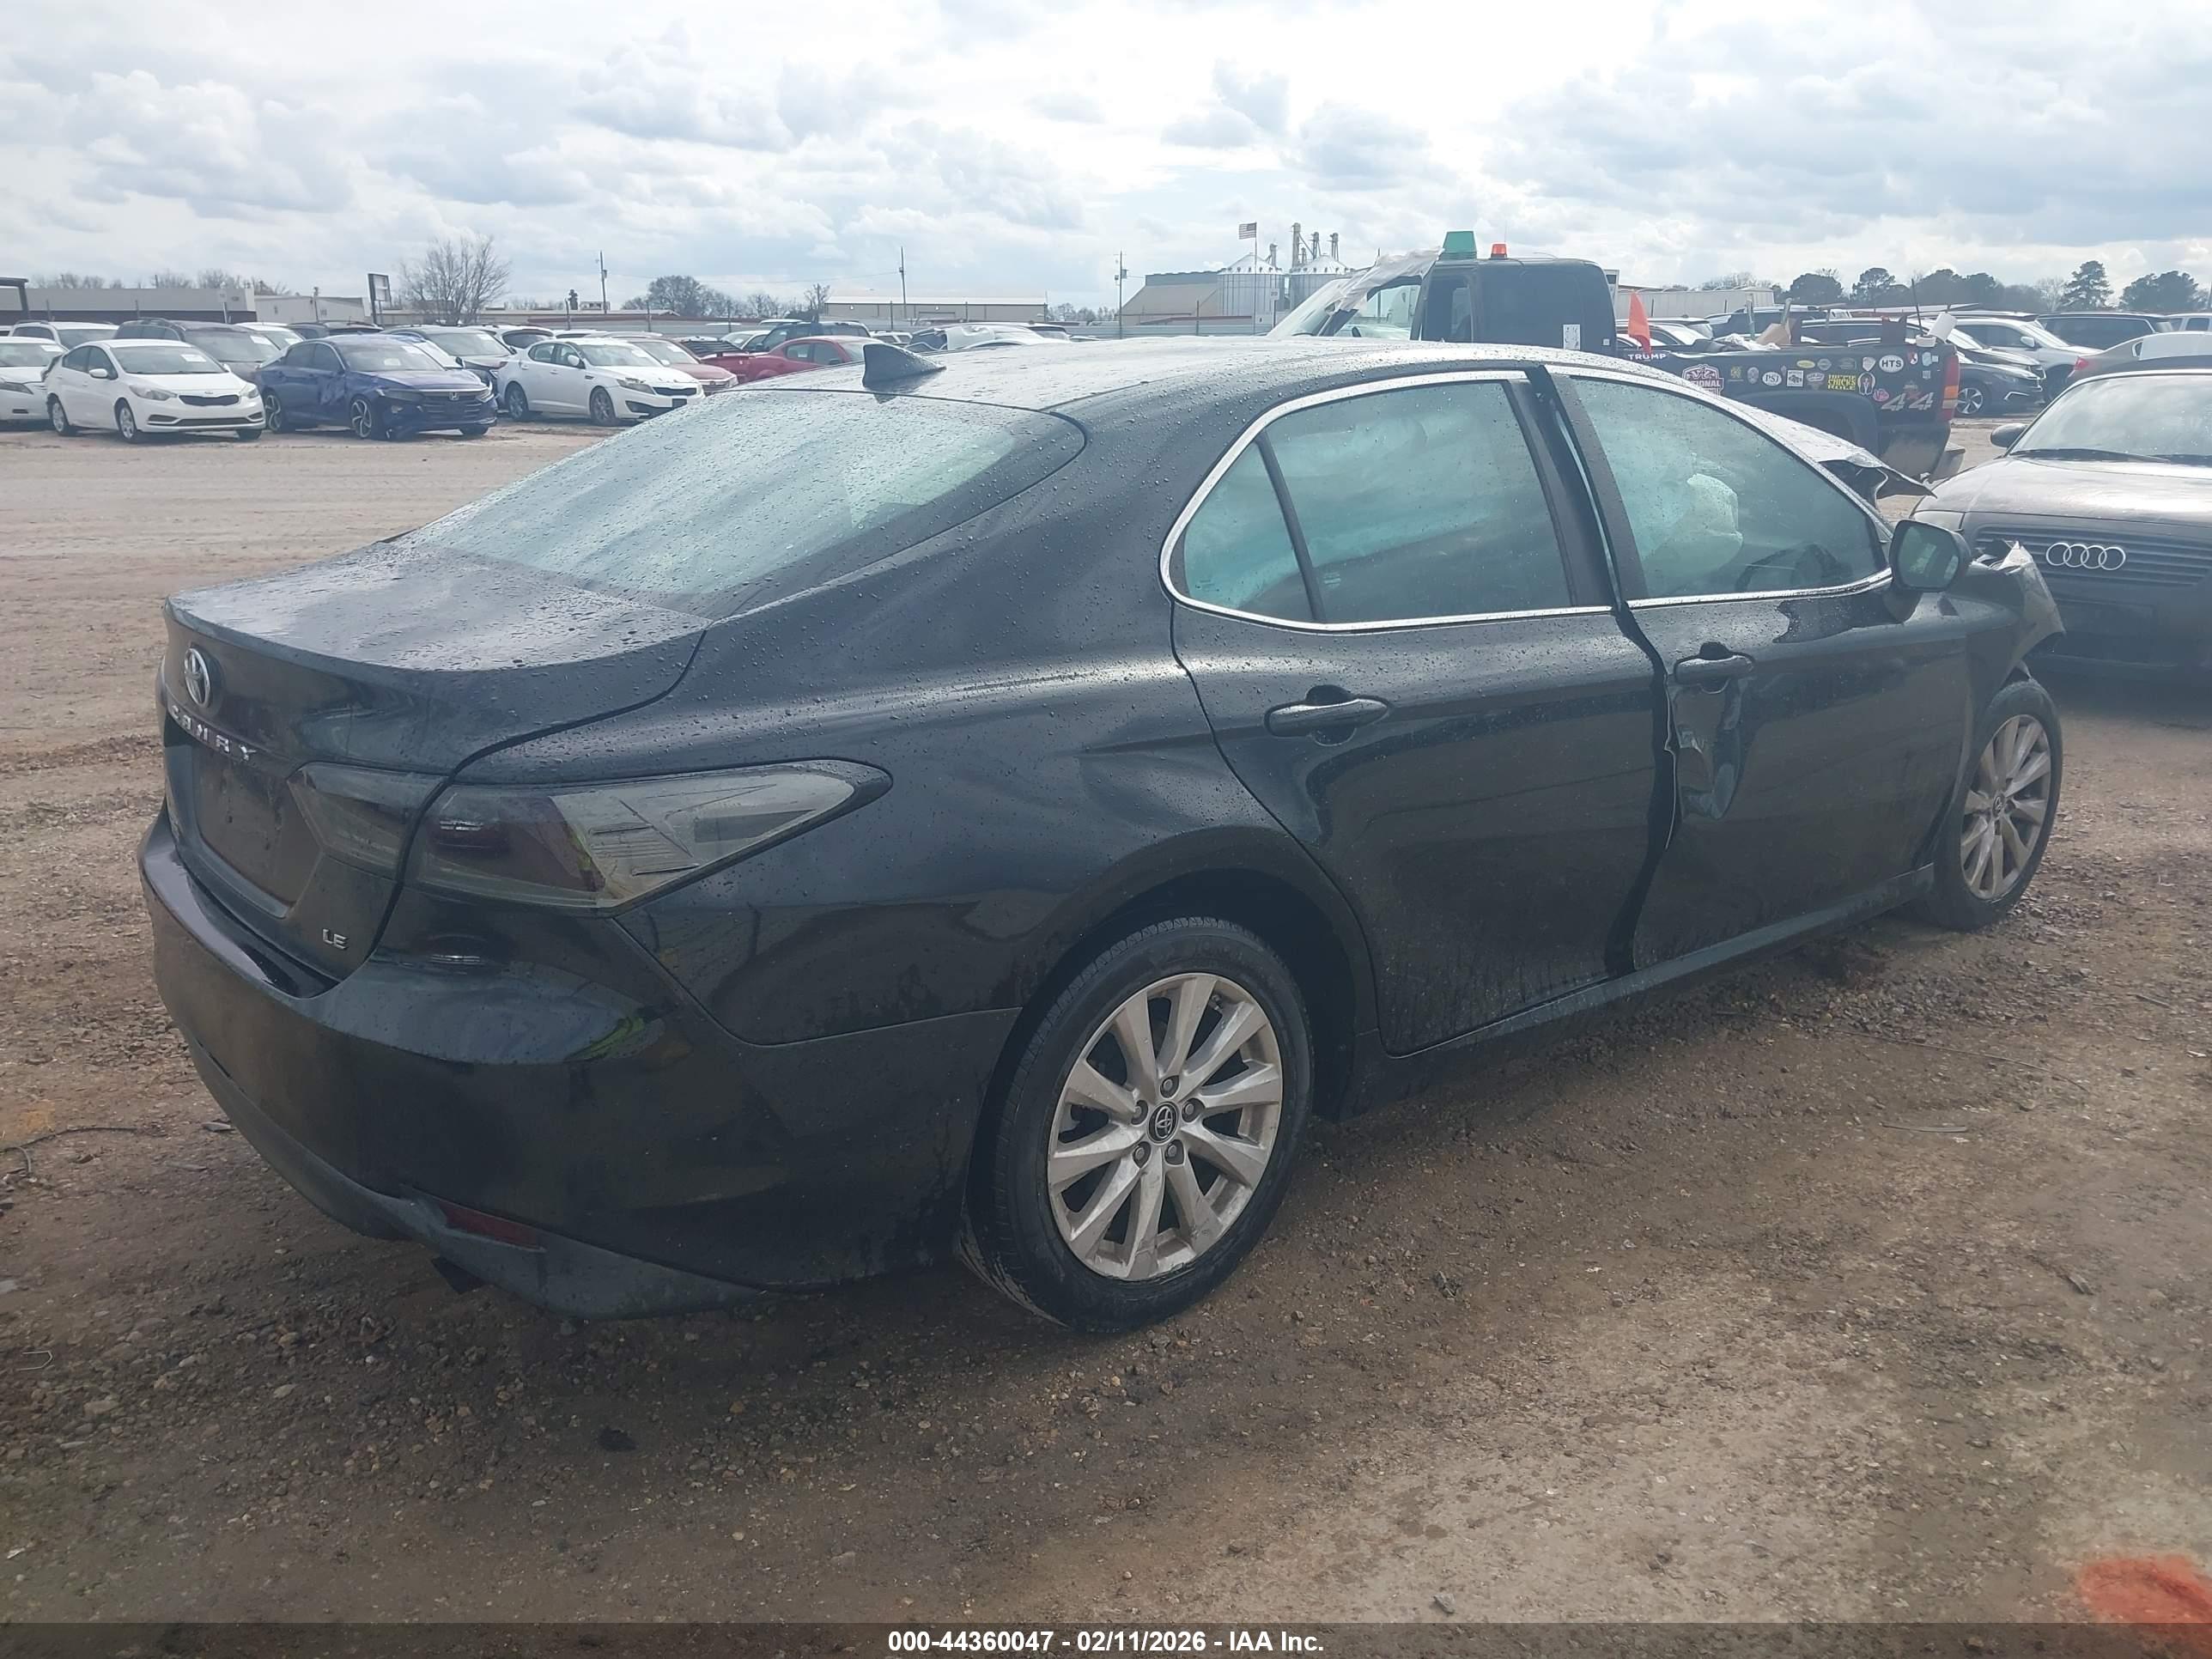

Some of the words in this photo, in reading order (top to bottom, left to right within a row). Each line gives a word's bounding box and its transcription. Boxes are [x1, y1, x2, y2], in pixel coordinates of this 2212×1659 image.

[1881, 359, 1902, 368] HTS
[171, 704, 258, 762] CAMRY
[322, 928, 347, 950] LE
